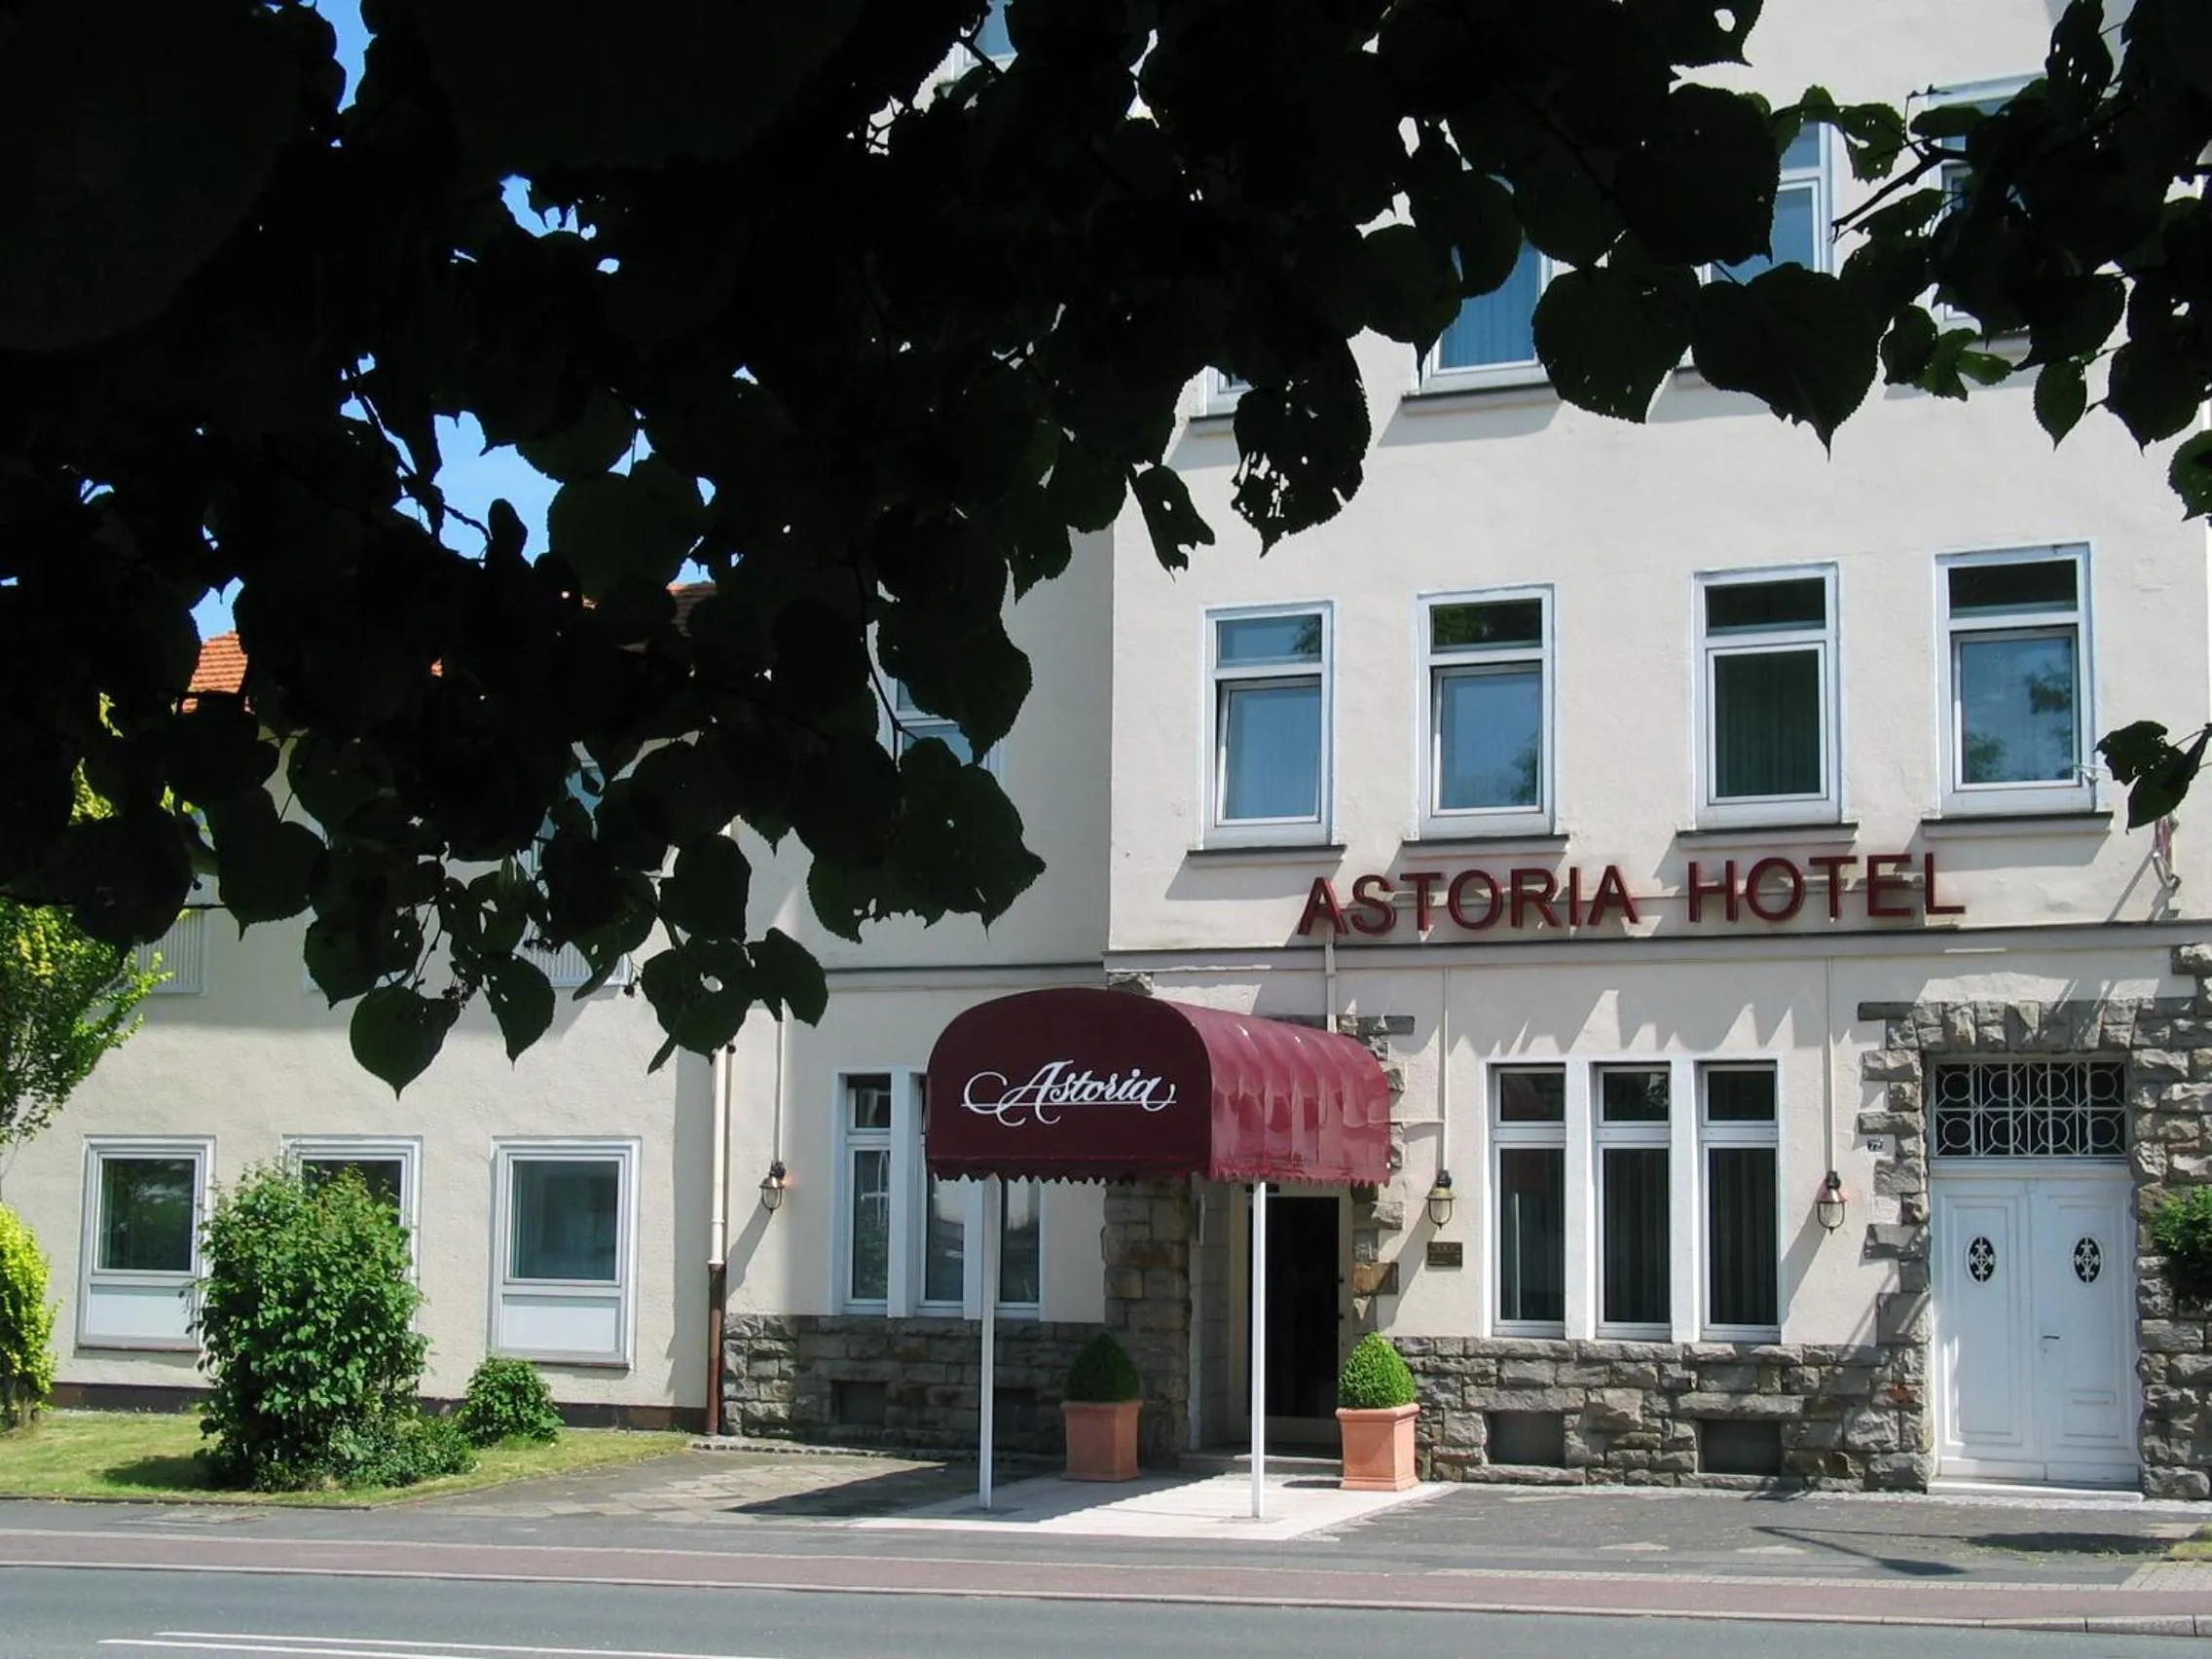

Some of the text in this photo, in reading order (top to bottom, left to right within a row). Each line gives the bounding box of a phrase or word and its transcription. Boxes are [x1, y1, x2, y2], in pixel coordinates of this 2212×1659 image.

[1298, 853, 1967, 936] ASTORIA HOTEL
[963, 1059, 1176, 1126] Astoria
